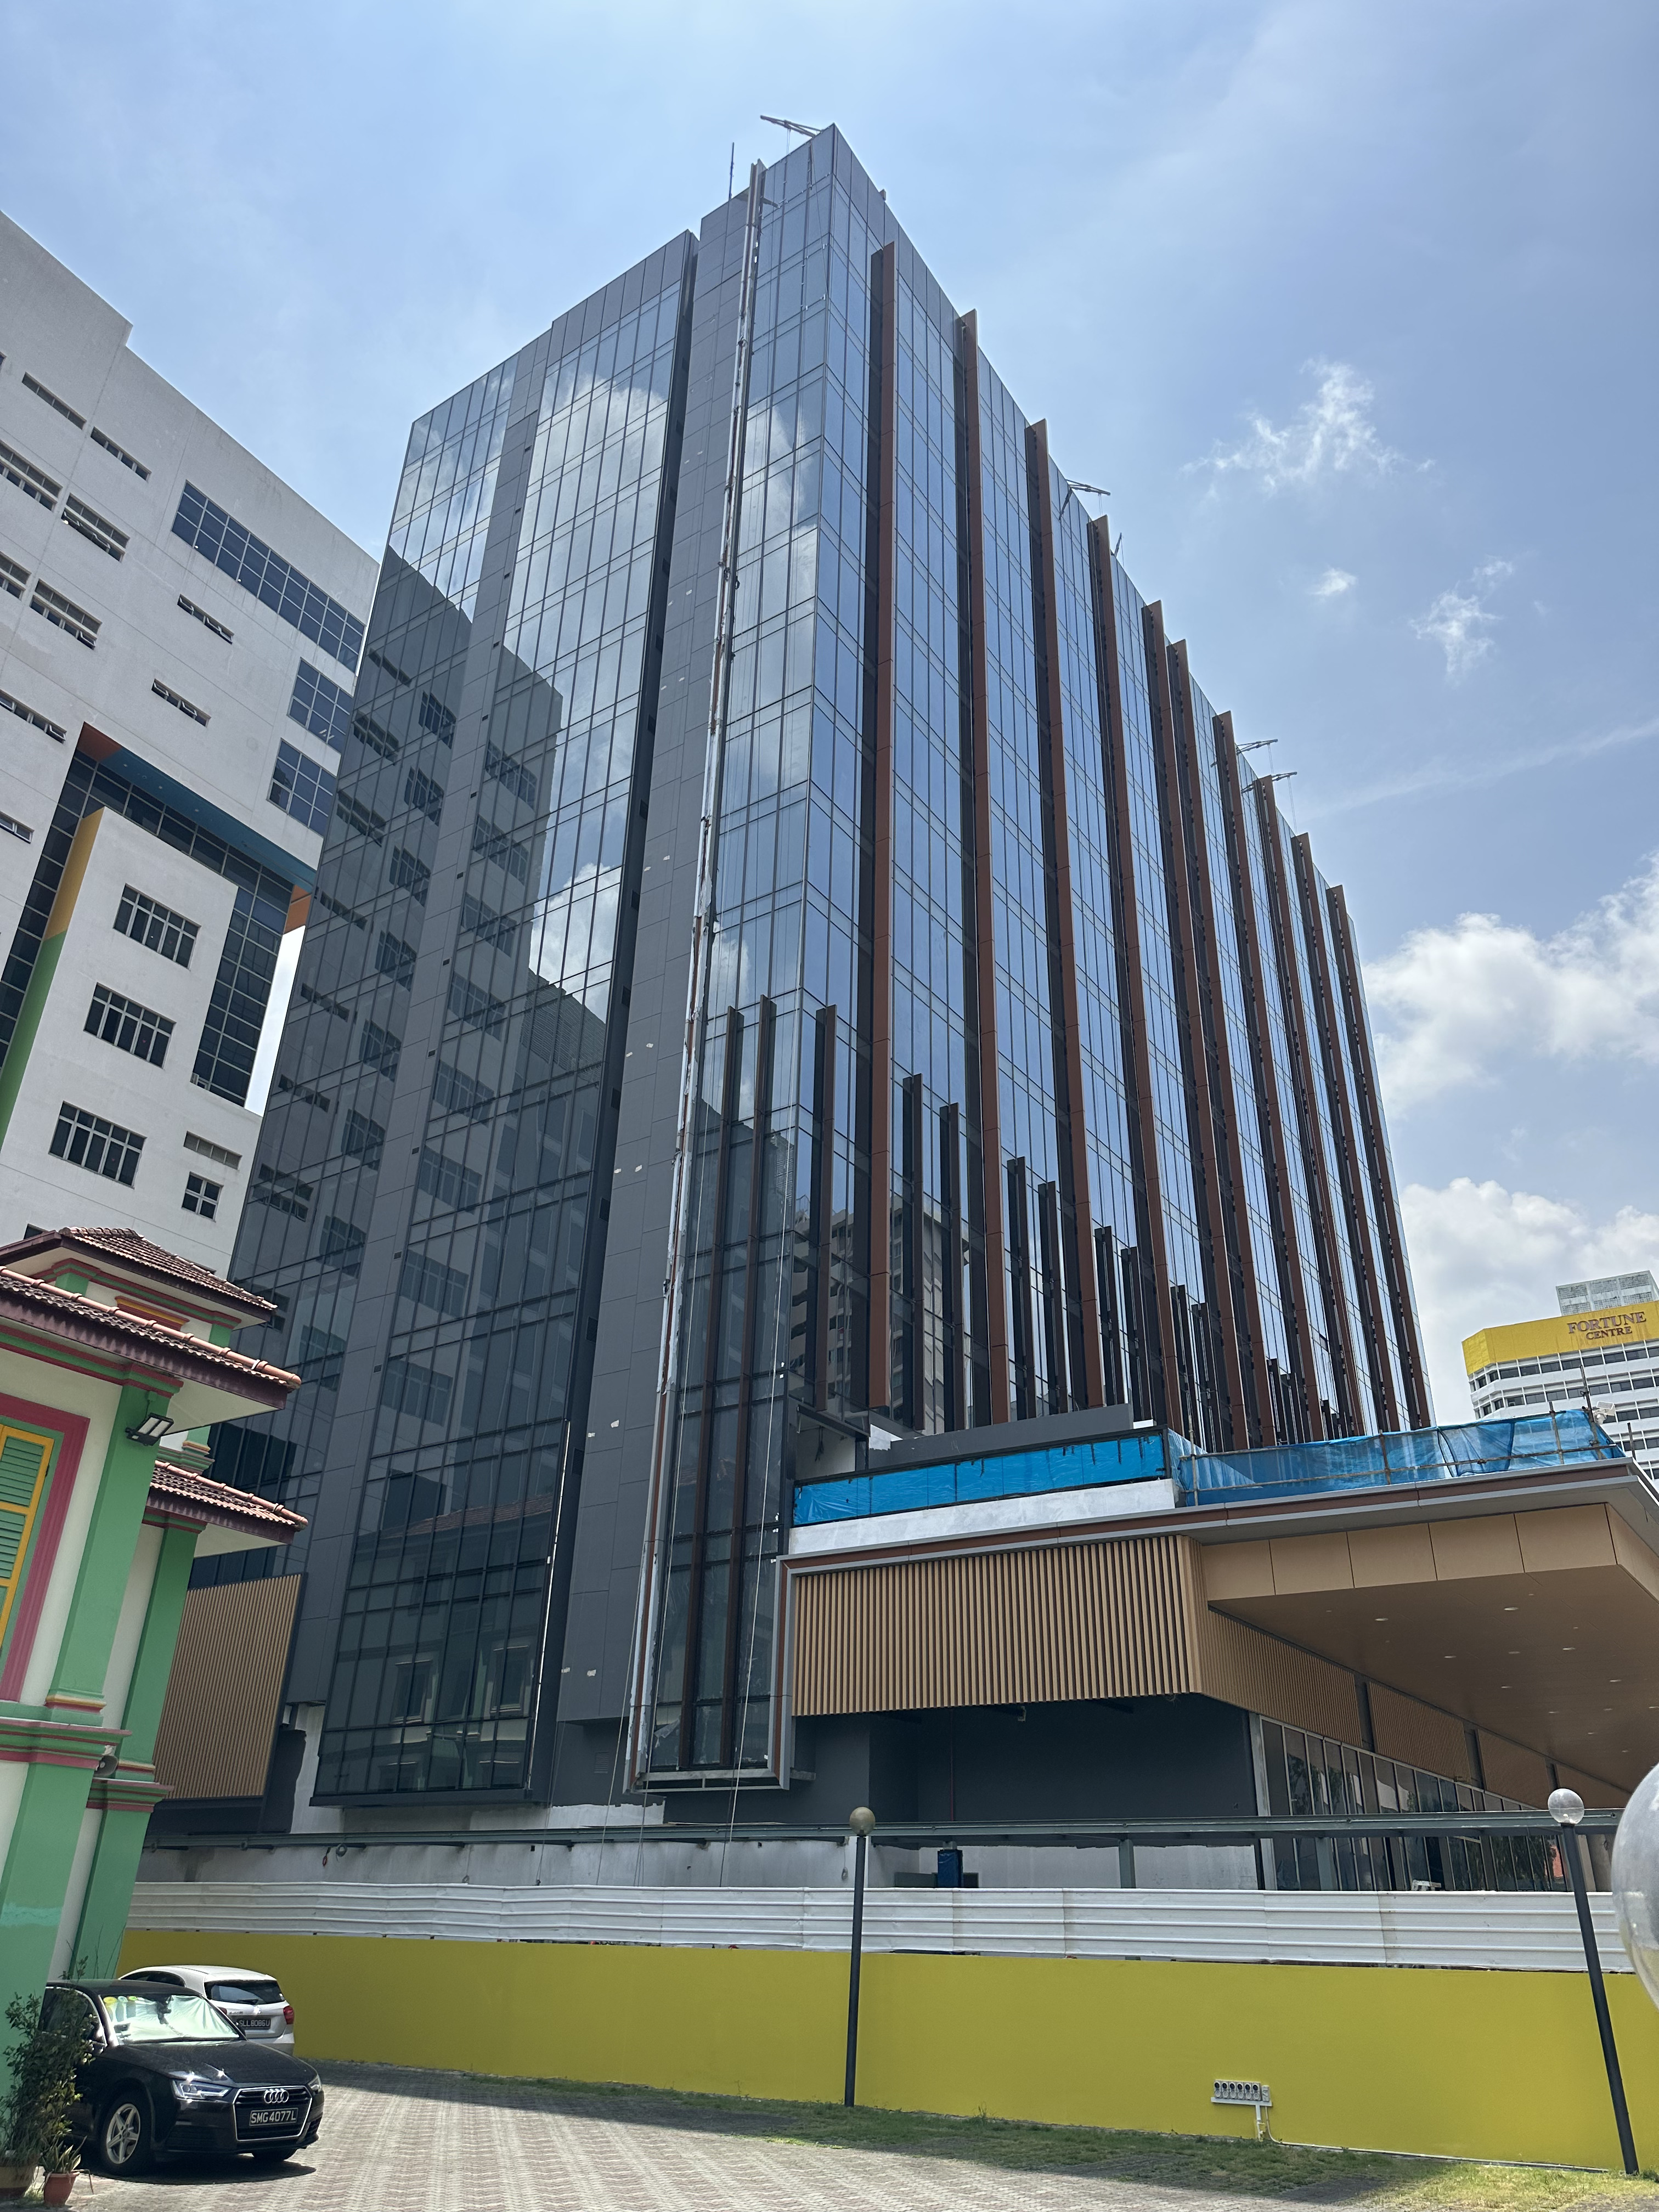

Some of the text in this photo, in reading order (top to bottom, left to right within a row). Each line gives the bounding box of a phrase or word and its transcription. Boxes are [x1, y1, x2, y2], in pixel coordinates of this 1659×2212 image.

[1567, 1311, 1646, 1334] FORTUNE
[1585, 1326, 1633, 1340] CENTRE
[251, 2110, 296, 2123] SMG4077L
